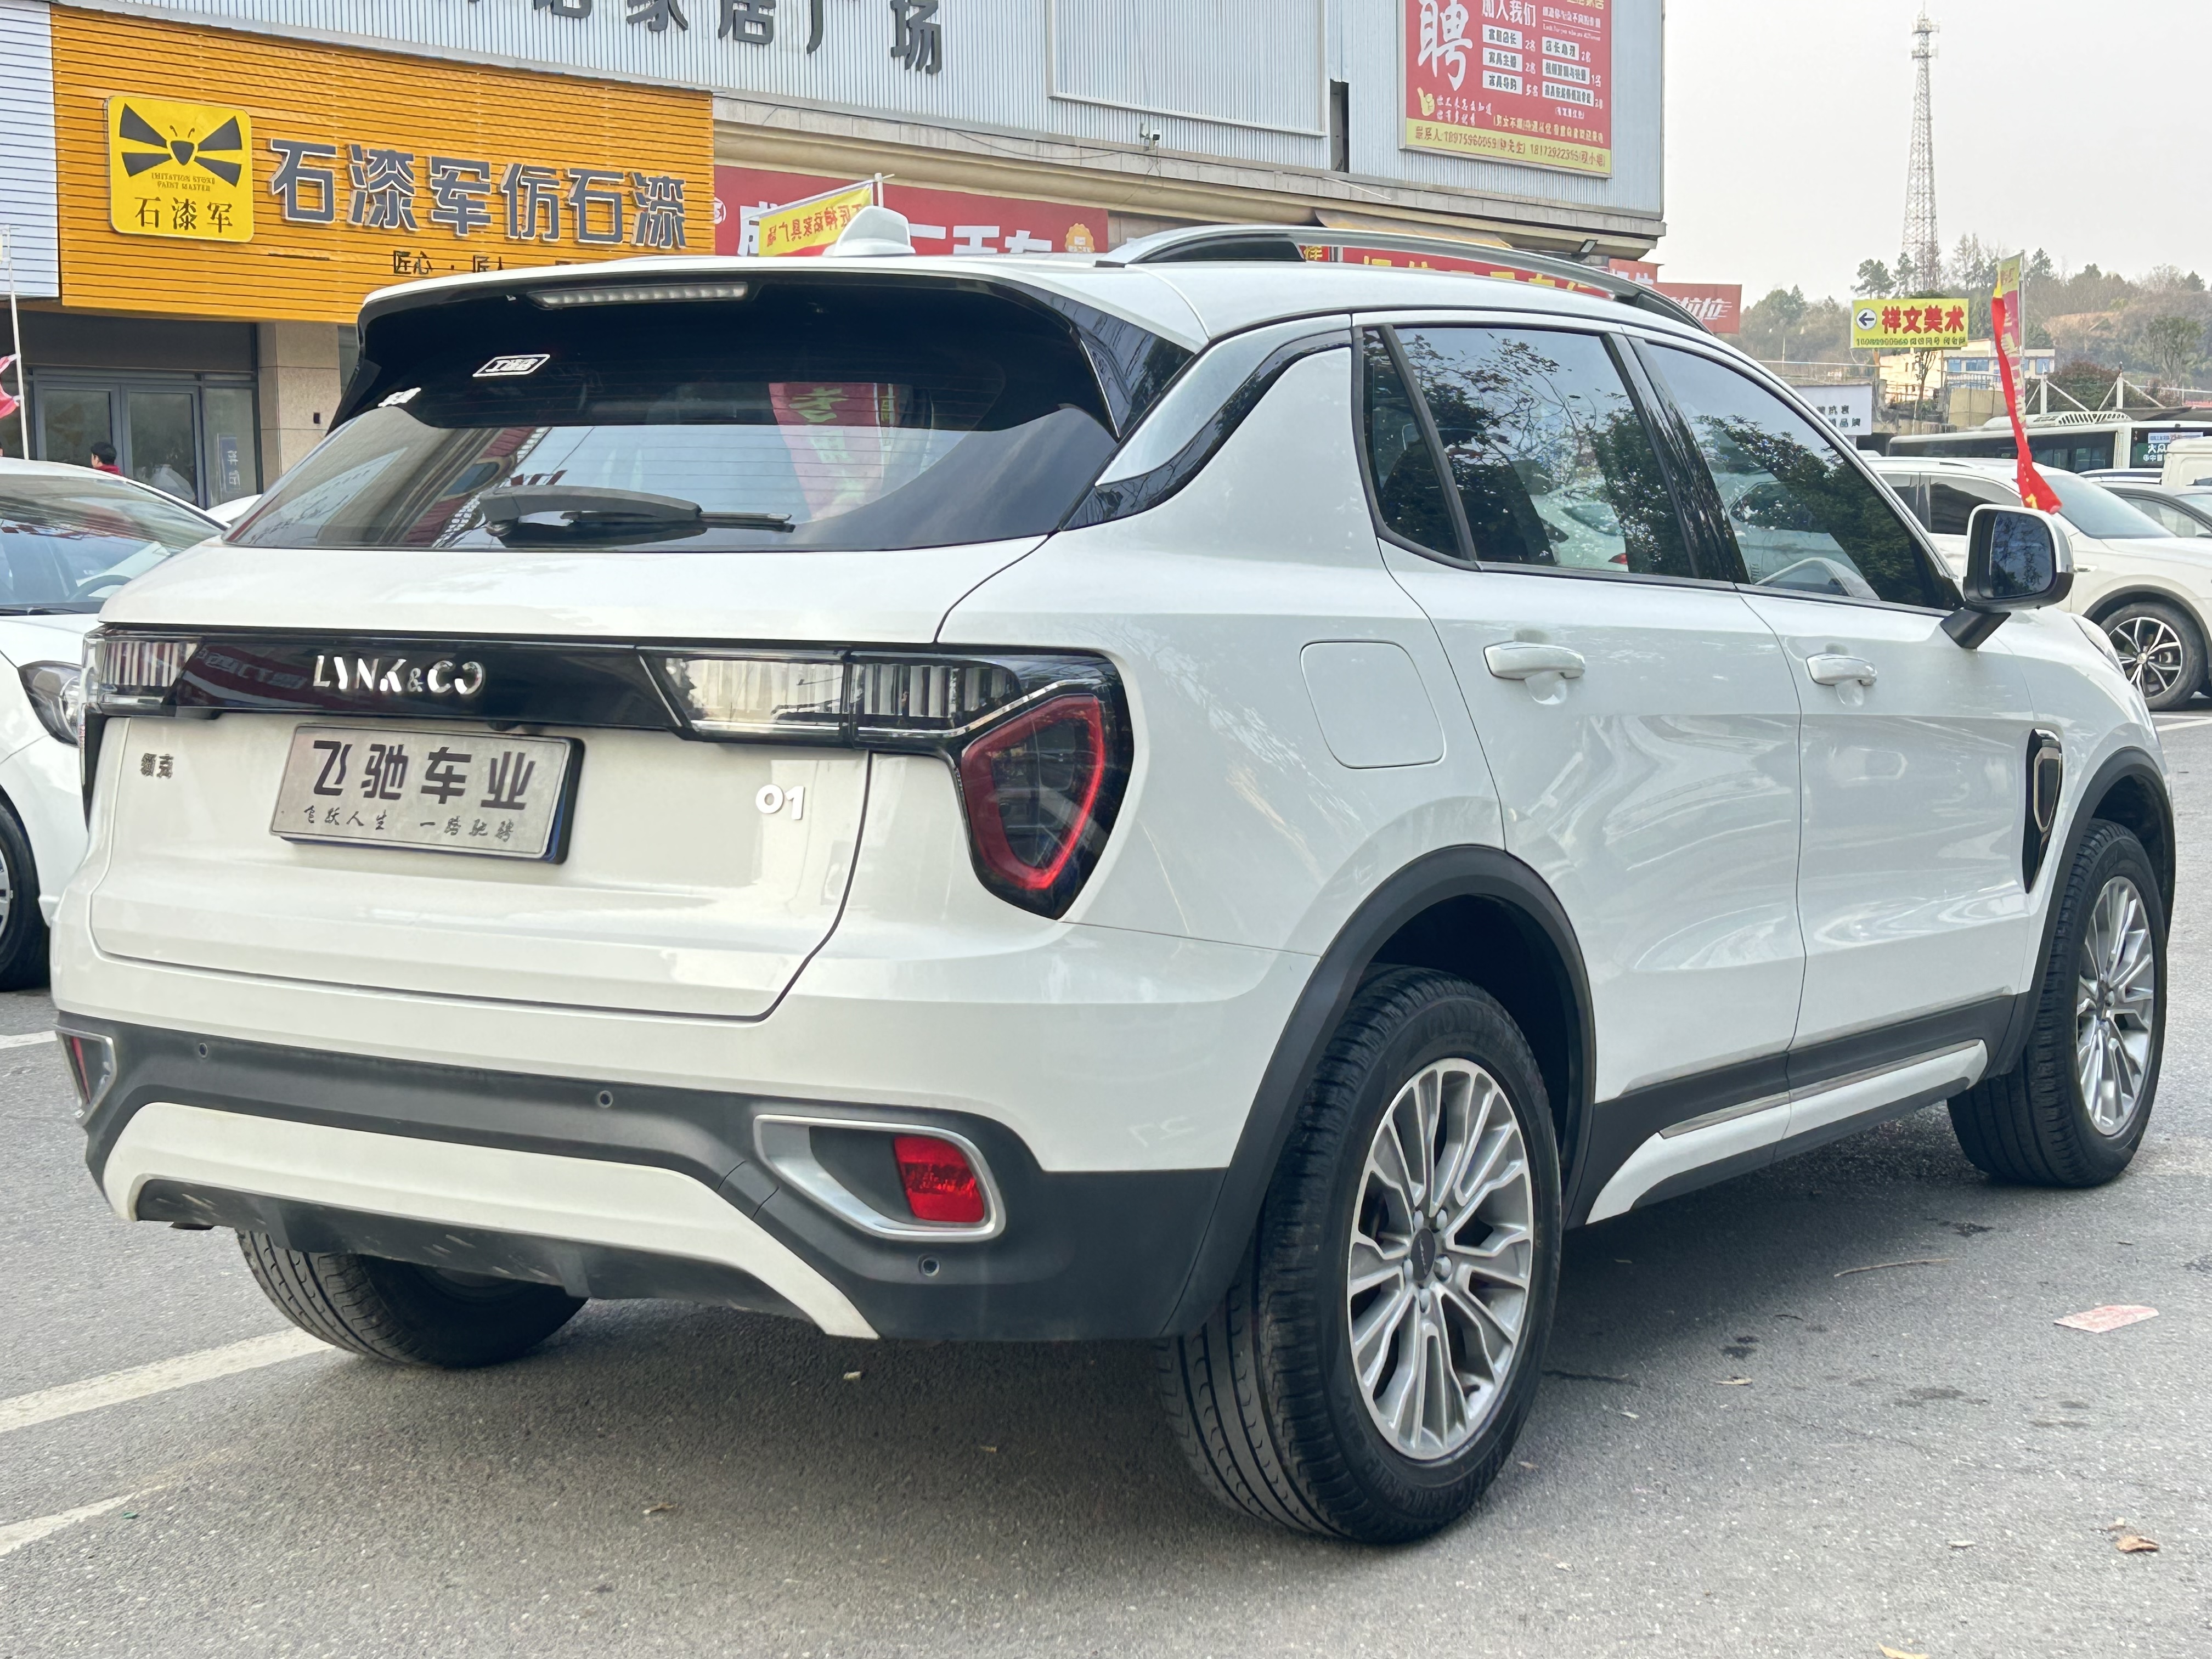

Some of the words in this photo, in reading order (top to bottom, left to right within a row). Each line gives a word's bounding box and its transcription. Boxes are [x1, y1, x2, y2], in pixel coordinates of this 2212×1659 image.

[1418, 0, 1473, 92] 聘
[135, 196, 233, 233] 石漆军
[268, 138, 687, 250] 石漆军仿石漆
[1882, 304, 1965, 334] 祥文美术
[313, 740, 536, 810] 飞驰车业
[755, 783, 806, 821] 01
